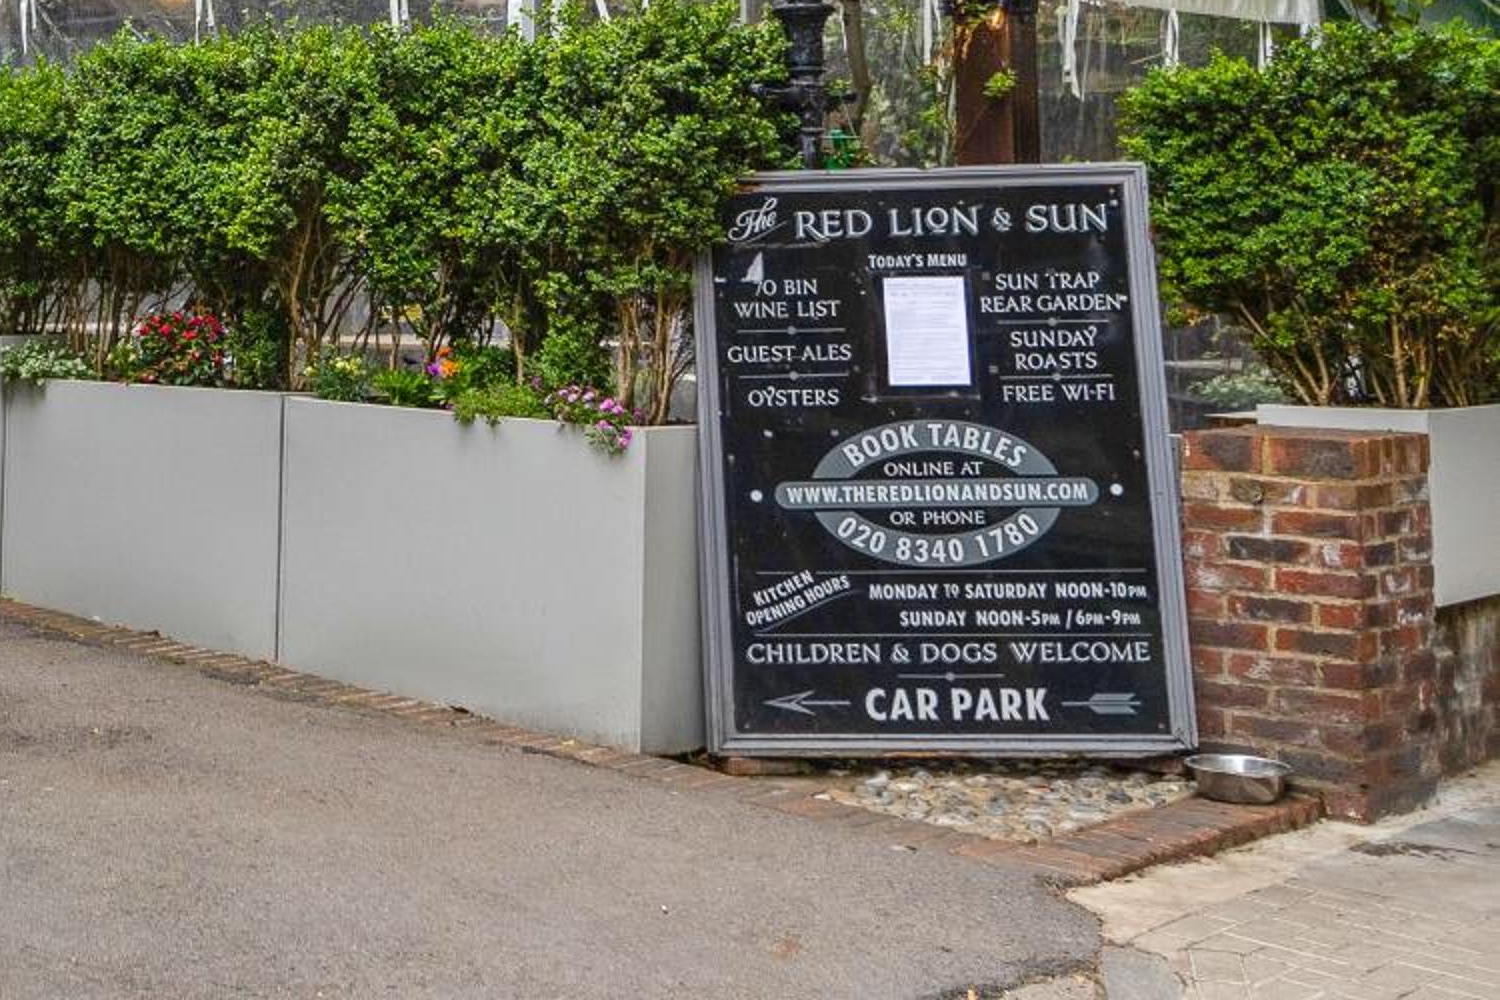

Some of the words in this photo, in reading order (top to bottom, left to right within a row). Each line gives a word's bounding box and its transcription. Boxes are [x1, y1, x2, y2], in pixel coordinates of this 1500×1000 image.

[727, 197, 781, 241] The
[793, 208, 873, 242] RED
[887, 204, 982, 237] LION
[991, 207, 1013, 233] &
[1025, 203, 1109, 234] SUN
[868, 253, 924, 270] TODAY'S
[926, 252, 967, 268] MENU
[784, 279, 818, 296] BIN
[995, 273, 1039, 291] SUN
[1045, 271, 1100, 290] TRAP
[734, 301, 789, 318] WINE
[797, 300, 841, 318] LIST
[980, 296, 1033, 313] REAR
[1037, 293, 1122, 312] GARDEN
[1010, 325, 1098, 347] SUNDAY
[727, 345, 796, 363] GUEST
[801, 343, 852, 361] ALES
[1014, 351, 1098, 370] ROASTS
[748, 385, 840, 407] OYSTERS
[1002, 384, 1055, 402] FREE
[1061, 383, 1116, 401] WI-FI
[842, 423, 919, 467] BOOK
[927, 423, 1027, 467] TABLES
[883, 461, 954, 477] ONLINE
[961, 461, 984, 476] AT
[786, 482, 1088, 504] WWW.THEREDLIONANDSUN.COM
[889, 511, 916, 525] OR
[923, 510, 986, 525] PHONE
[837, 516, 887, 554] 020
[896, 538, 964, 563] 8340
[974, 512, 1040, 558] 1780
[752, 569, 815, 607] KITCHEN
[869, 583, 938, 600] MONDAY
[943, 583, 960, 599] TO
[965, 582, 1048, 600] SATURDAY
[1055, 581, 1148, 600] NOON-10PM
[745, 594, 806, 626] OPENING
[803, 575, 851, 606] HOURS
[899, 609, 967, 627] SUNDAY
[975, 609, 1061, 627] NOON-5PM
[747, 642, 882, 665] CHILDREN
[891, 643, 911, 664] &
[920, 642, 998, 664] DOGS
[1008, 640, 1152, 664] WELCOME
[865, 688, 940, 722] CAR
[951, 687, 1051, 722] PARK
